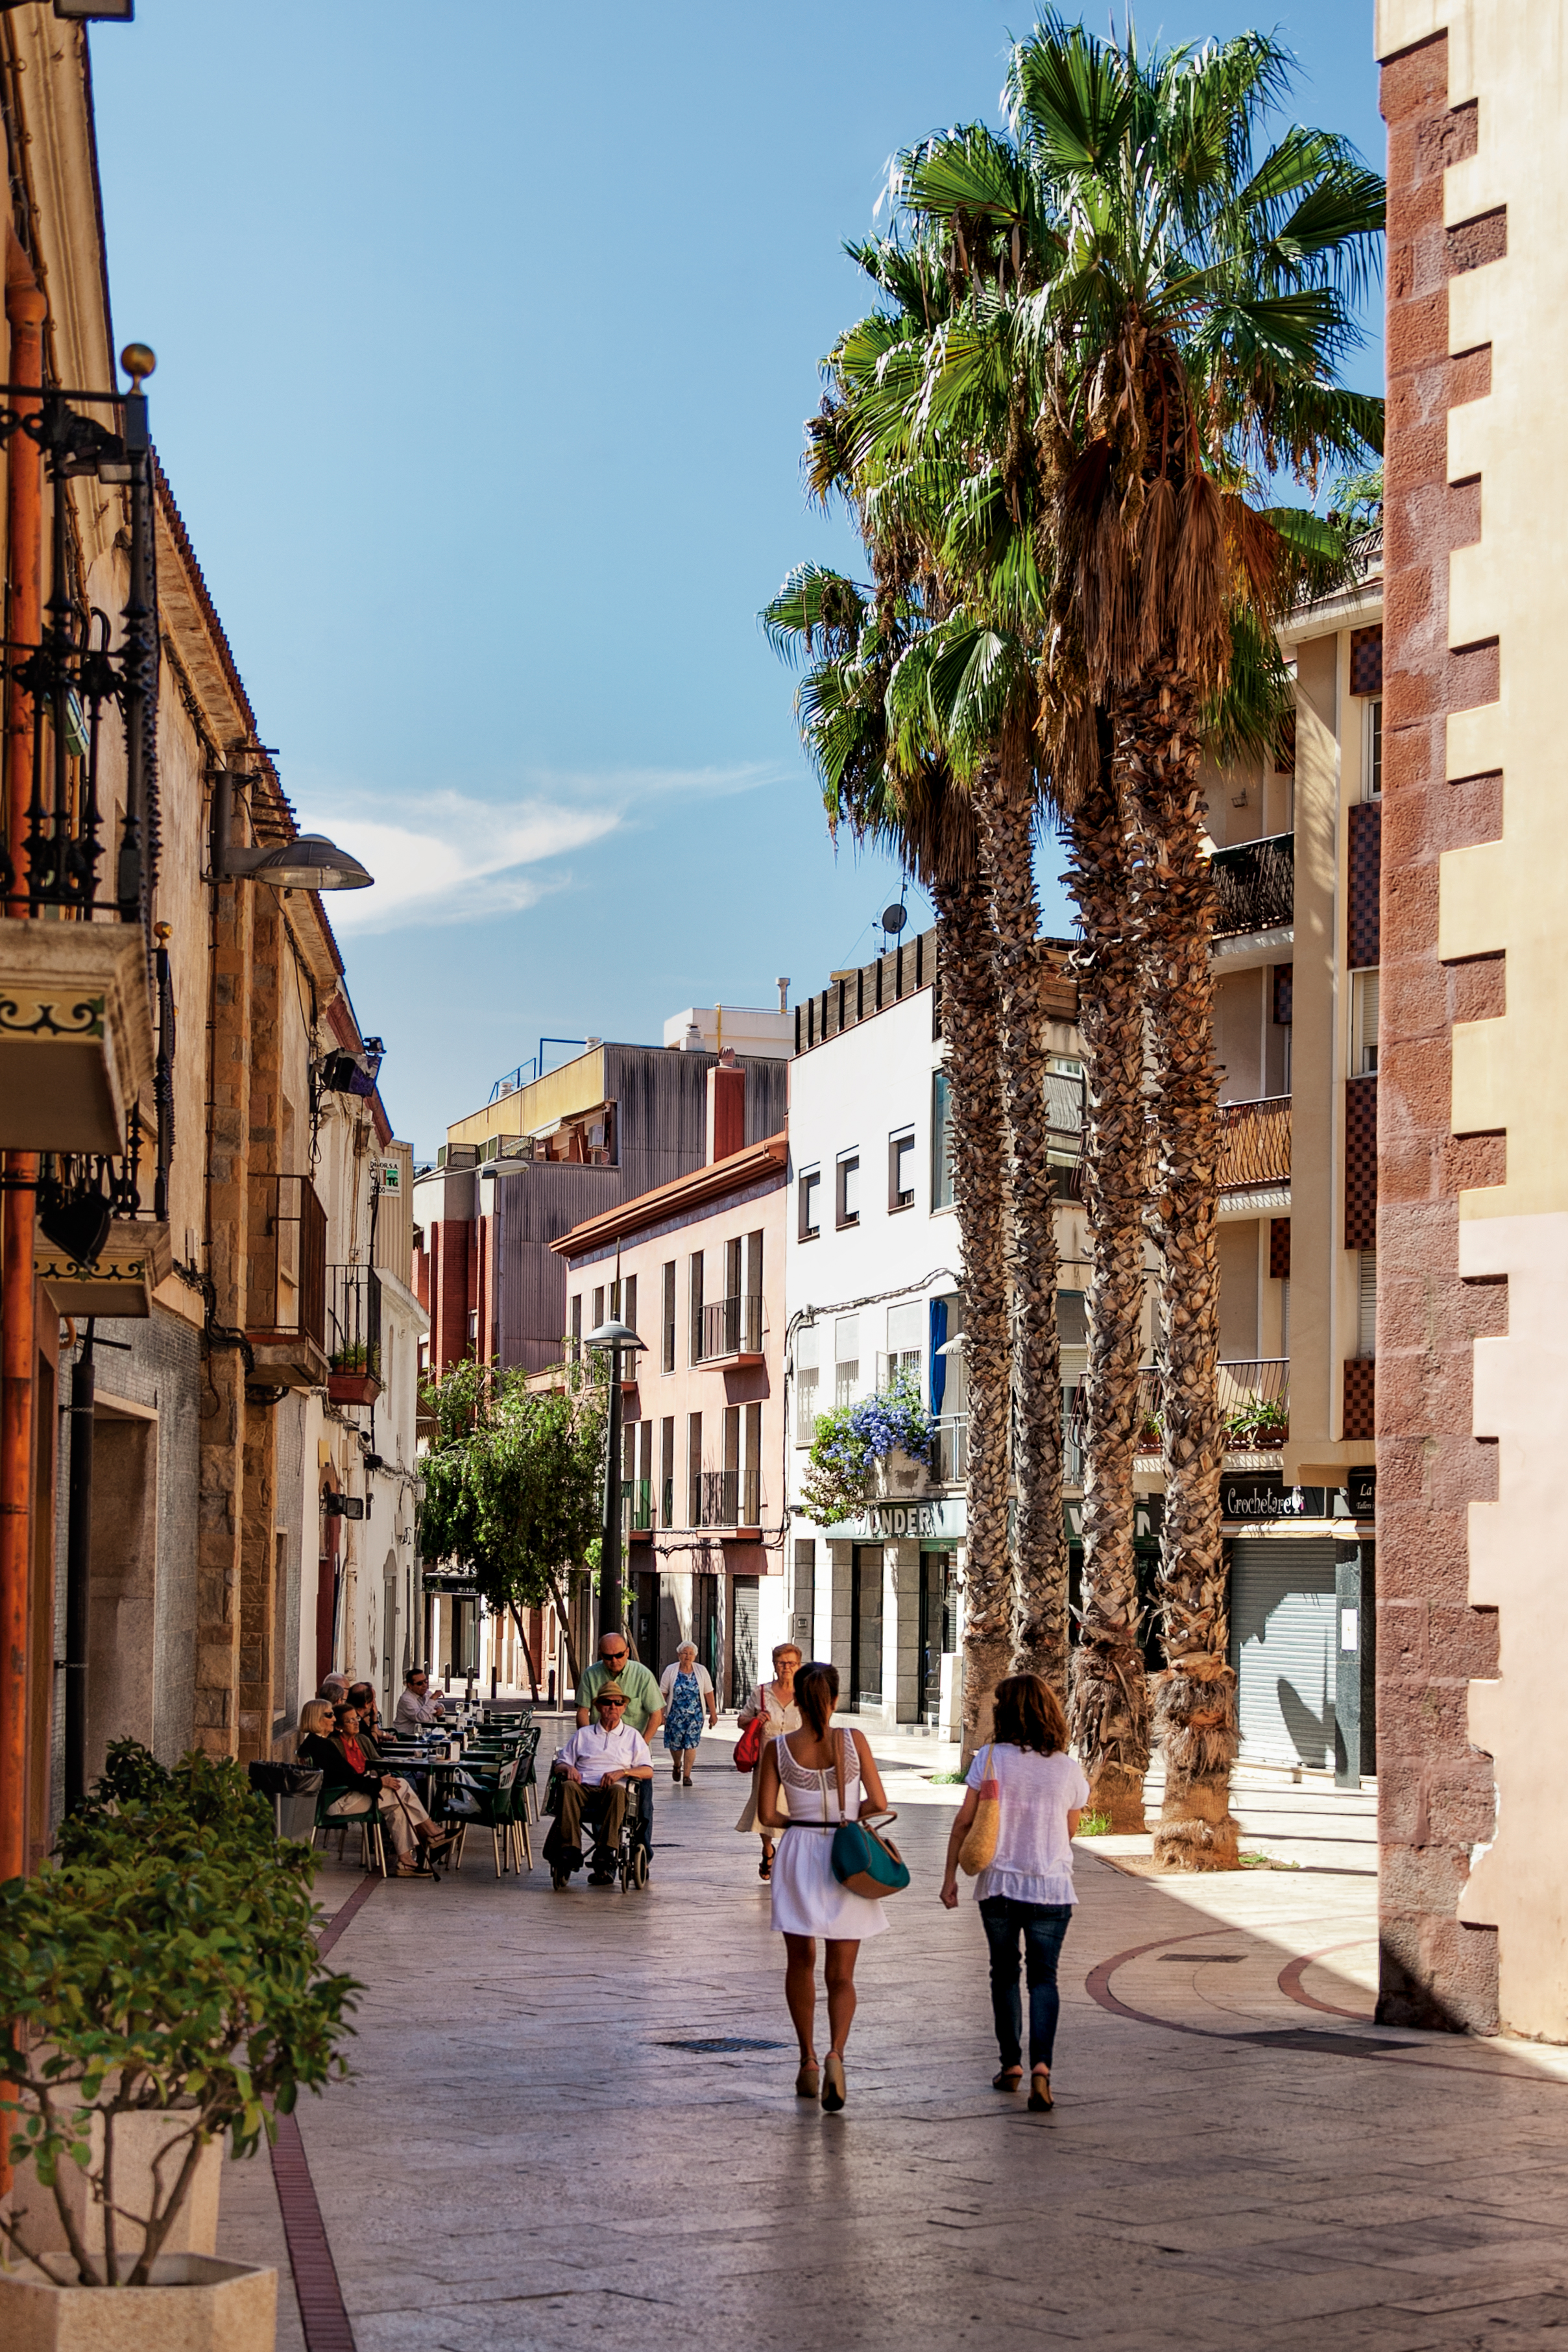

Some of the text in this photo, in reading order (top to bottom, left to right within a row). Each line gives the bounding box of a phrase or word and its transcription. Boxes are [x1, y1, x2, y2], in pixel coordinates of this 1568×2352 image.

[1360, 1483, 1372, 1496] La
[1357, 1501, 1371, 1509] Tallers
[852, 1507, 932, 1534] WONDER
